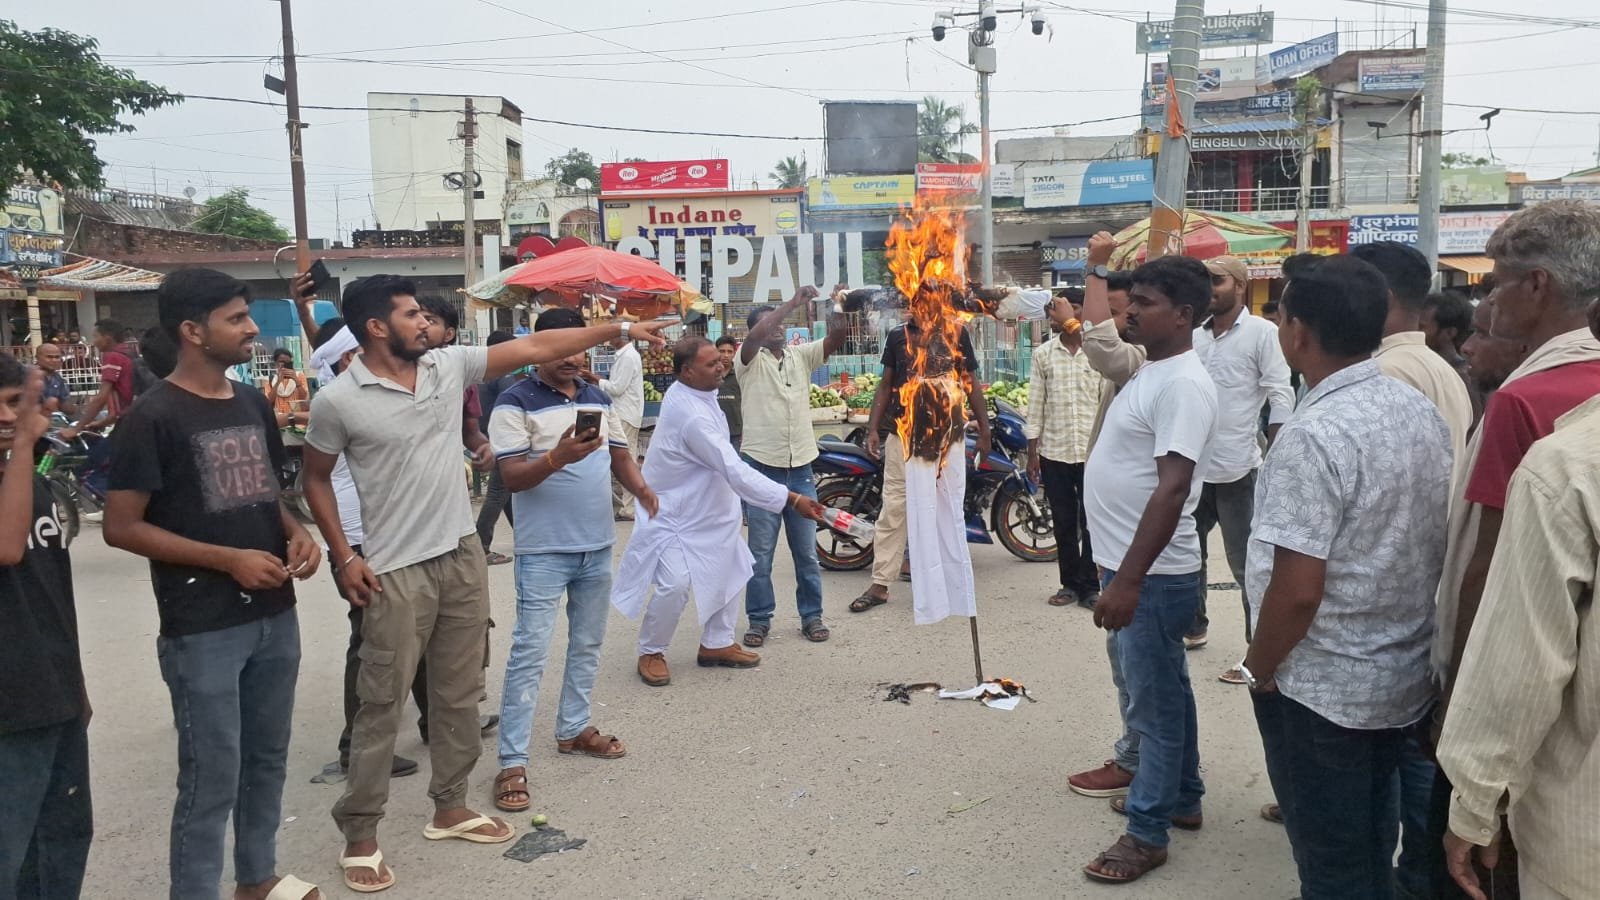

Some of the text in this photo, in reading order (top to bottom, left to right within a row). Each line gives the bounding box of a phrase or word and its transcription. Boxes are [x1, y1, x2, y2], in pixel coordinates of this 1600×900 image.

[1207, 14, 1265, 30] LIBRARY
[1271, 39, 1335, 70] LOAN OFFICE
[853, 180, 899, 190] CAPTAIN
[1090, 174, 1147, 185] SUNIL STEEL
[648, 205, 742, 225] Indane
[1068, 247, 1089, 260] SB
[208, 435, 262, 467] SOLO
[215, 463, 271, 498] VIBE
